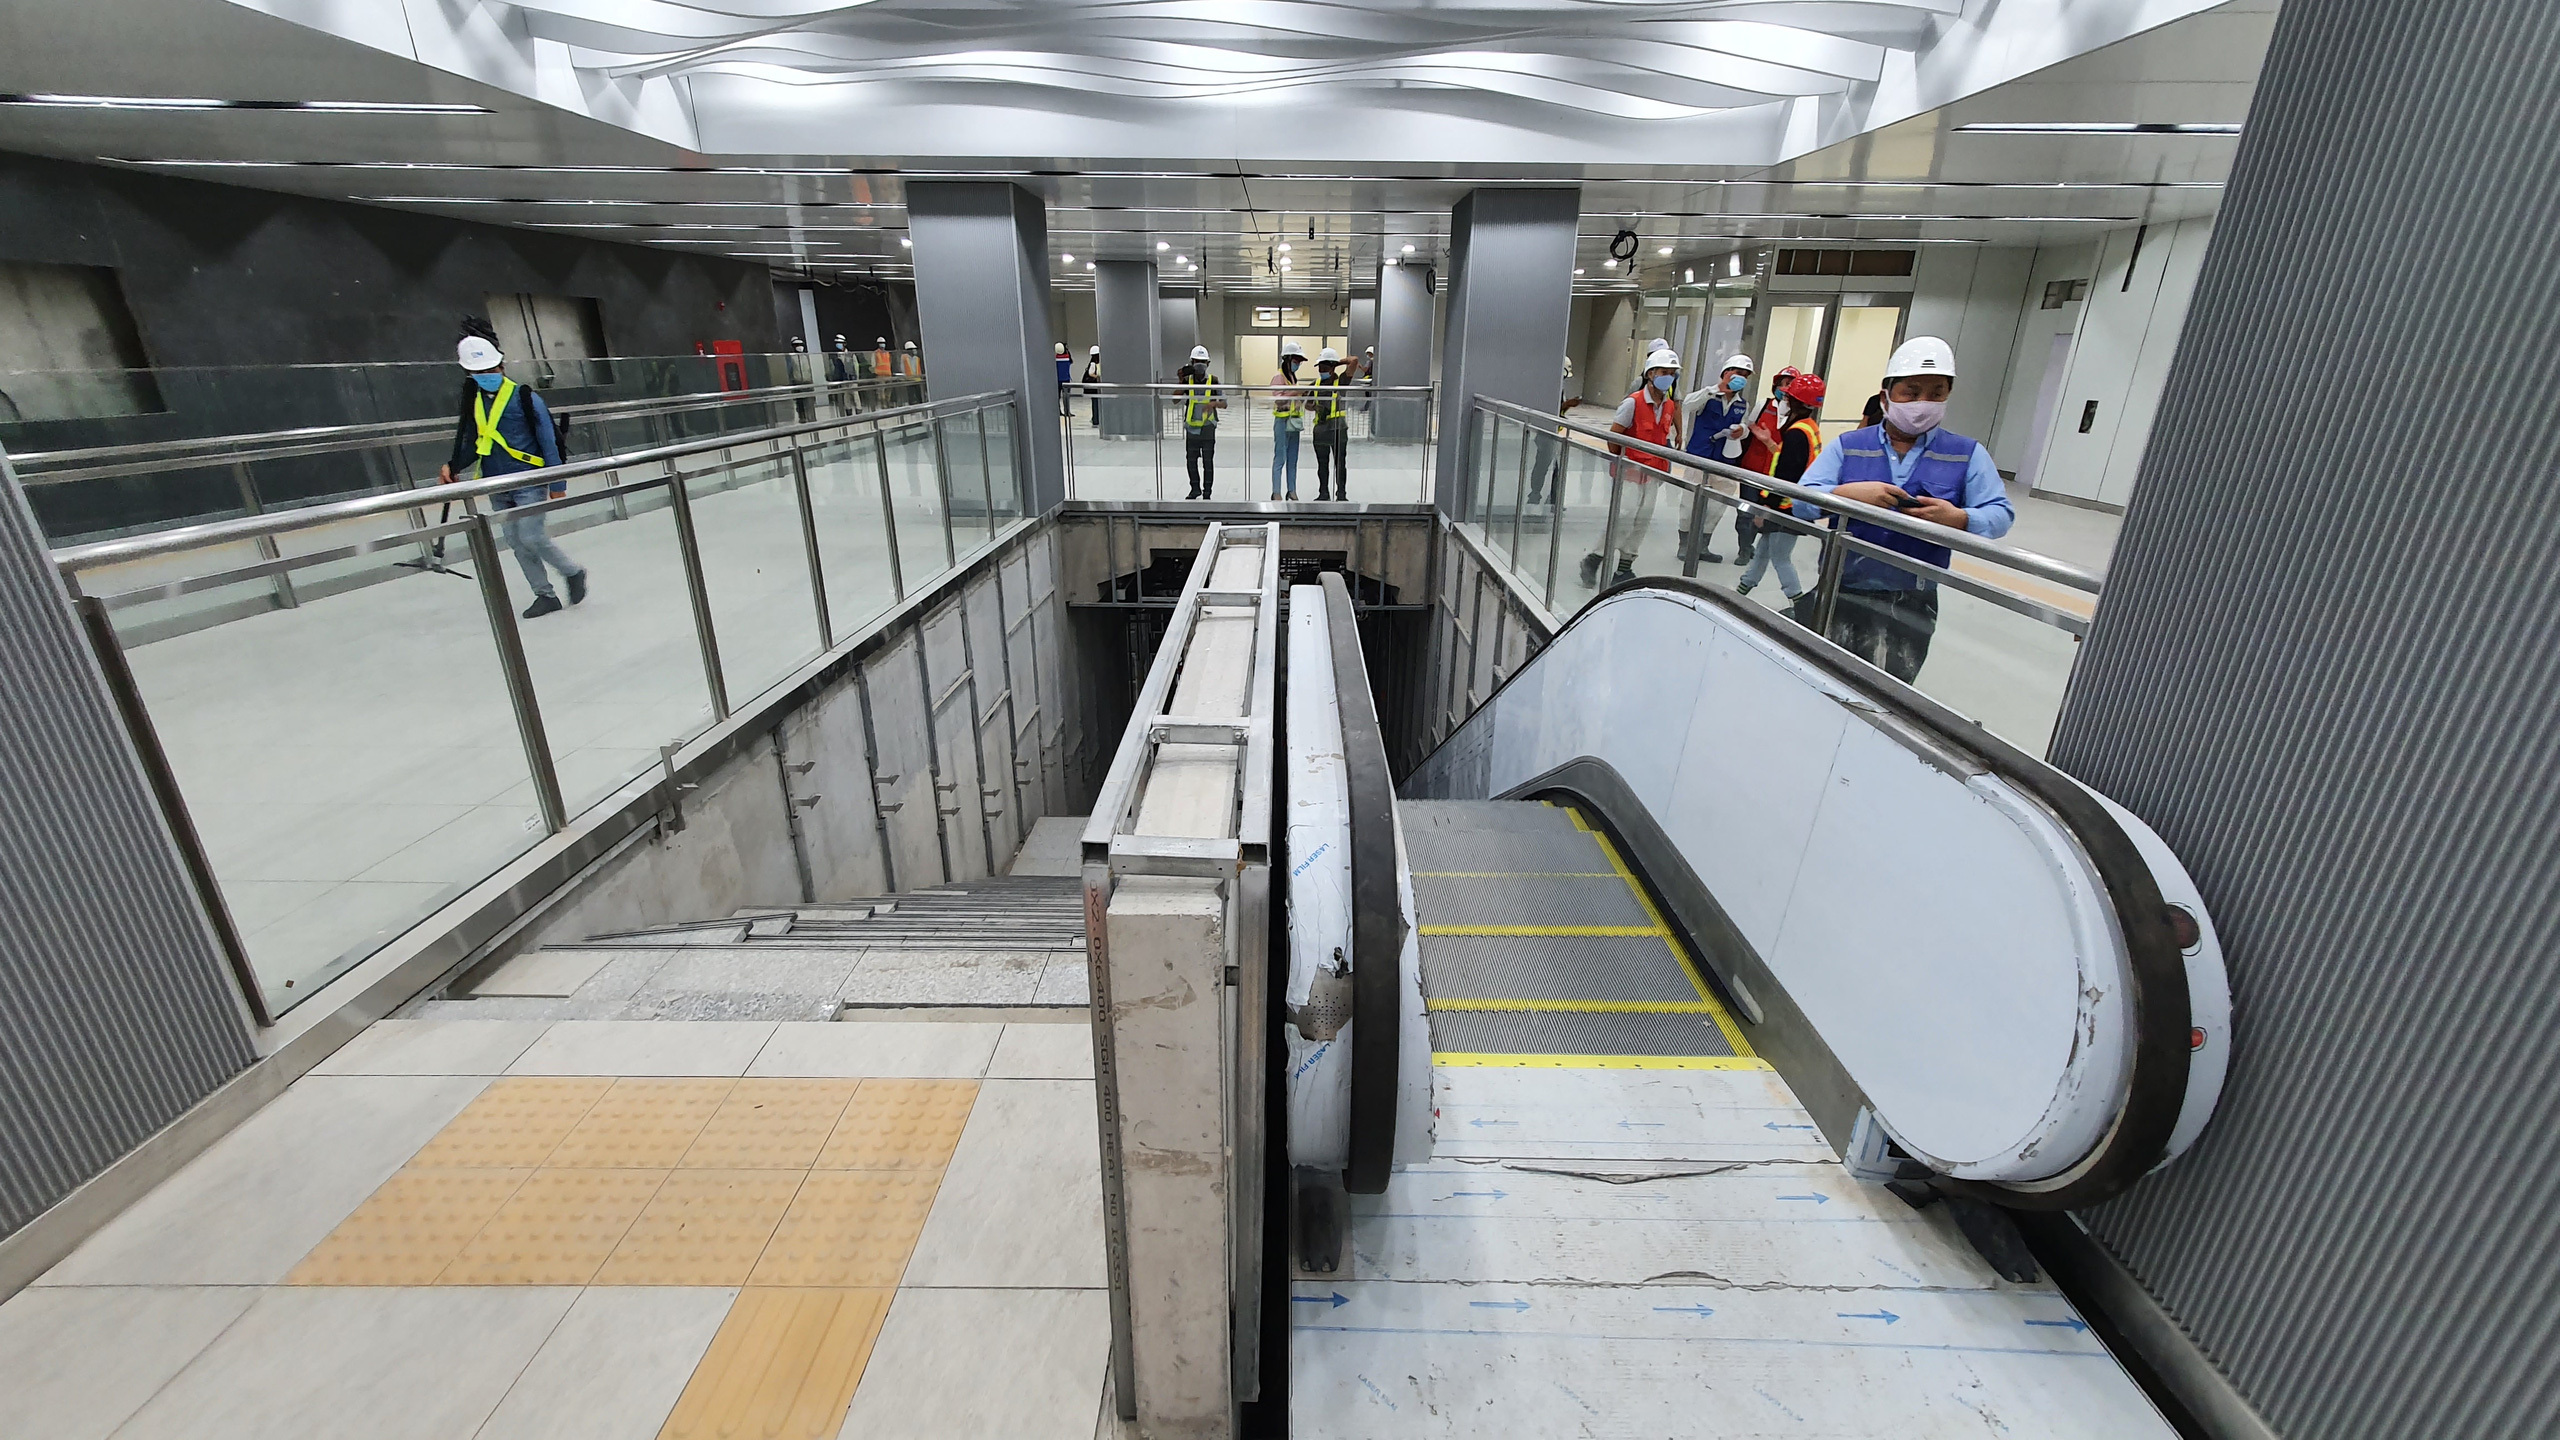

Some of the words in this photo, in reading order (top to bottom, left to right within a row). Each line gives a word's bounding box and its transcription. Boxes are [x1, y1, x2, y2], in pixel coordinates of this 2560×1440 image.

[1306, 842, 1330, 863] LASER
[1292, 860, 1311, 878] FILM
[1099, 1034, 1111, 1075] SGH
[1307, 1042, 1332, 1066] LASER
[1103, 1085, 1113, 1122] 400
[1106, 1132, 1116, 1181] HEAT
